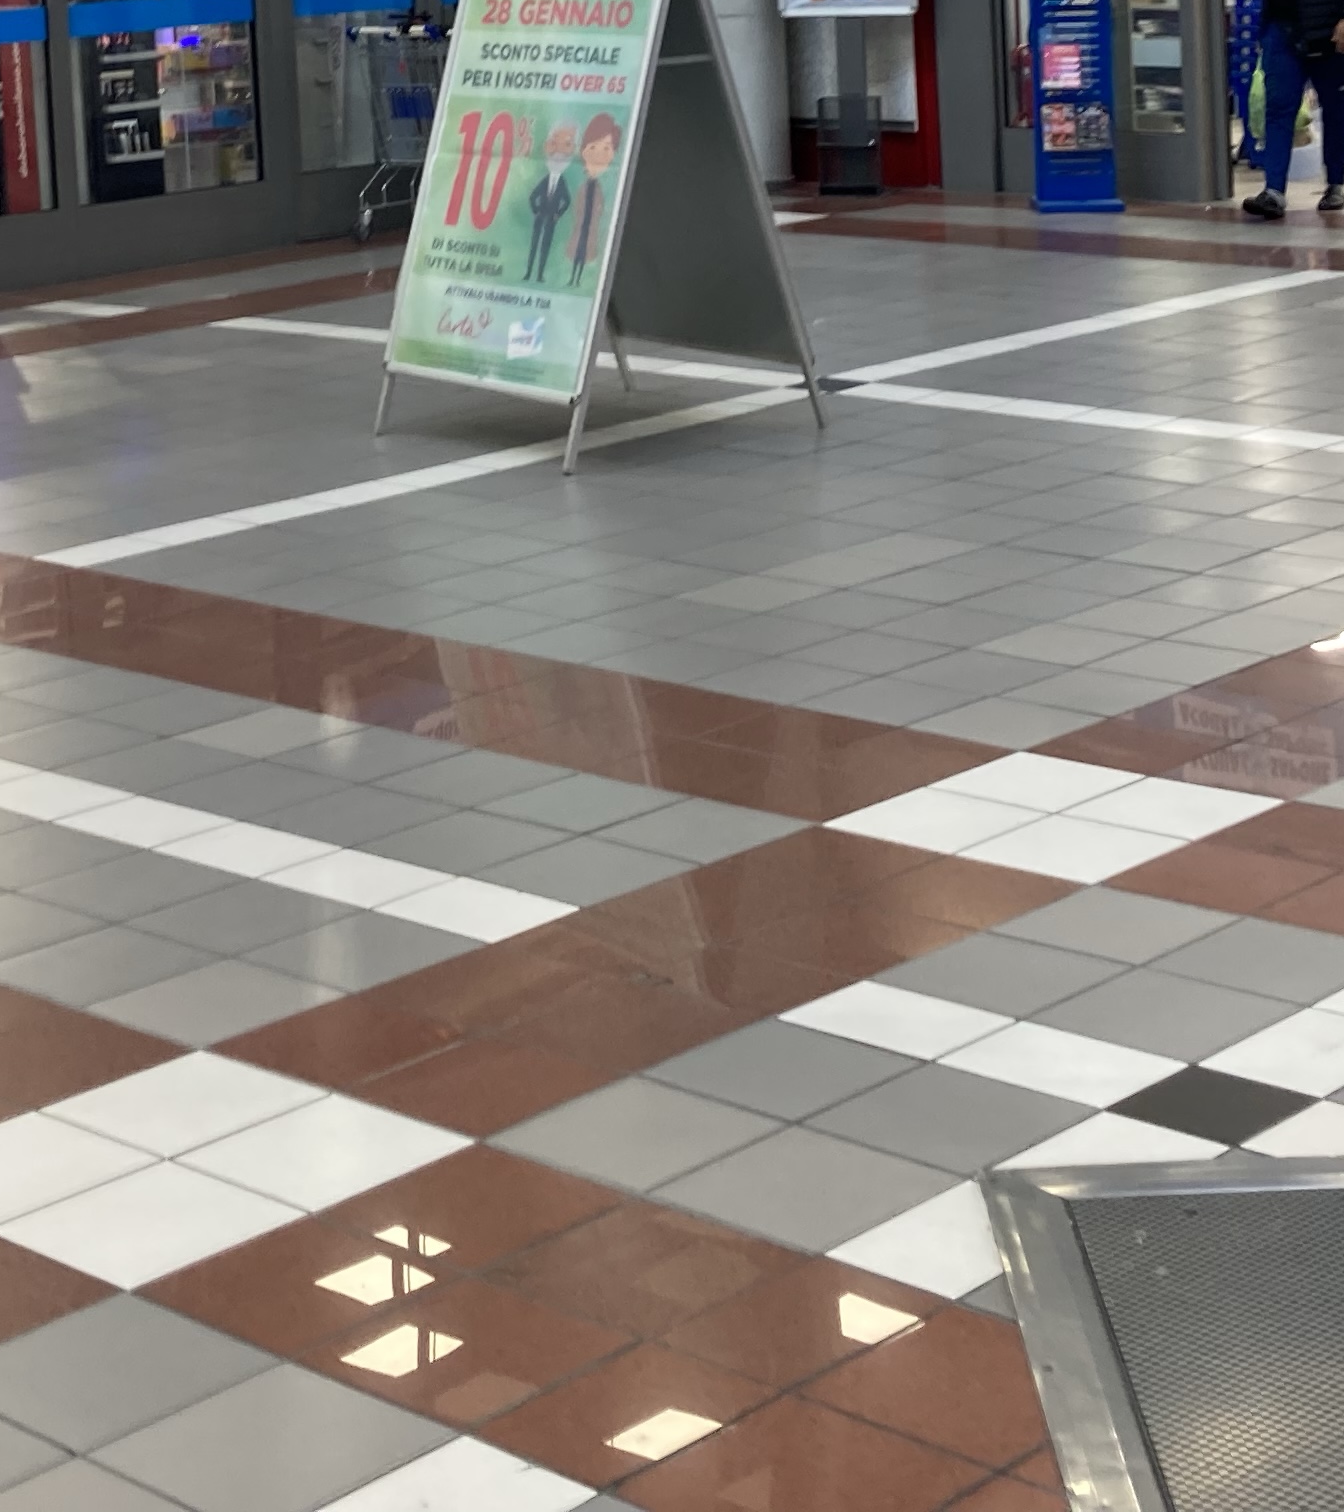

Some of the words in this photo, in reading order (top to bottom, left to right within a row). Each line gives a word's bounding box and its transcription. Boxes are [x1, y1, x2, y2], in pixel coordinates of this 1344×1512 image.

[481, 42, 541, 62] SCONTO
[544, 45, 621, 65] SPECIALE
[462, 69, 492, 87] PER
[495, 71, 503, 86] I
[504, 71, 557, 89] NOSTRI
[560, 74, 604, 92] OVER
[606, 77, 627, 94] 65
